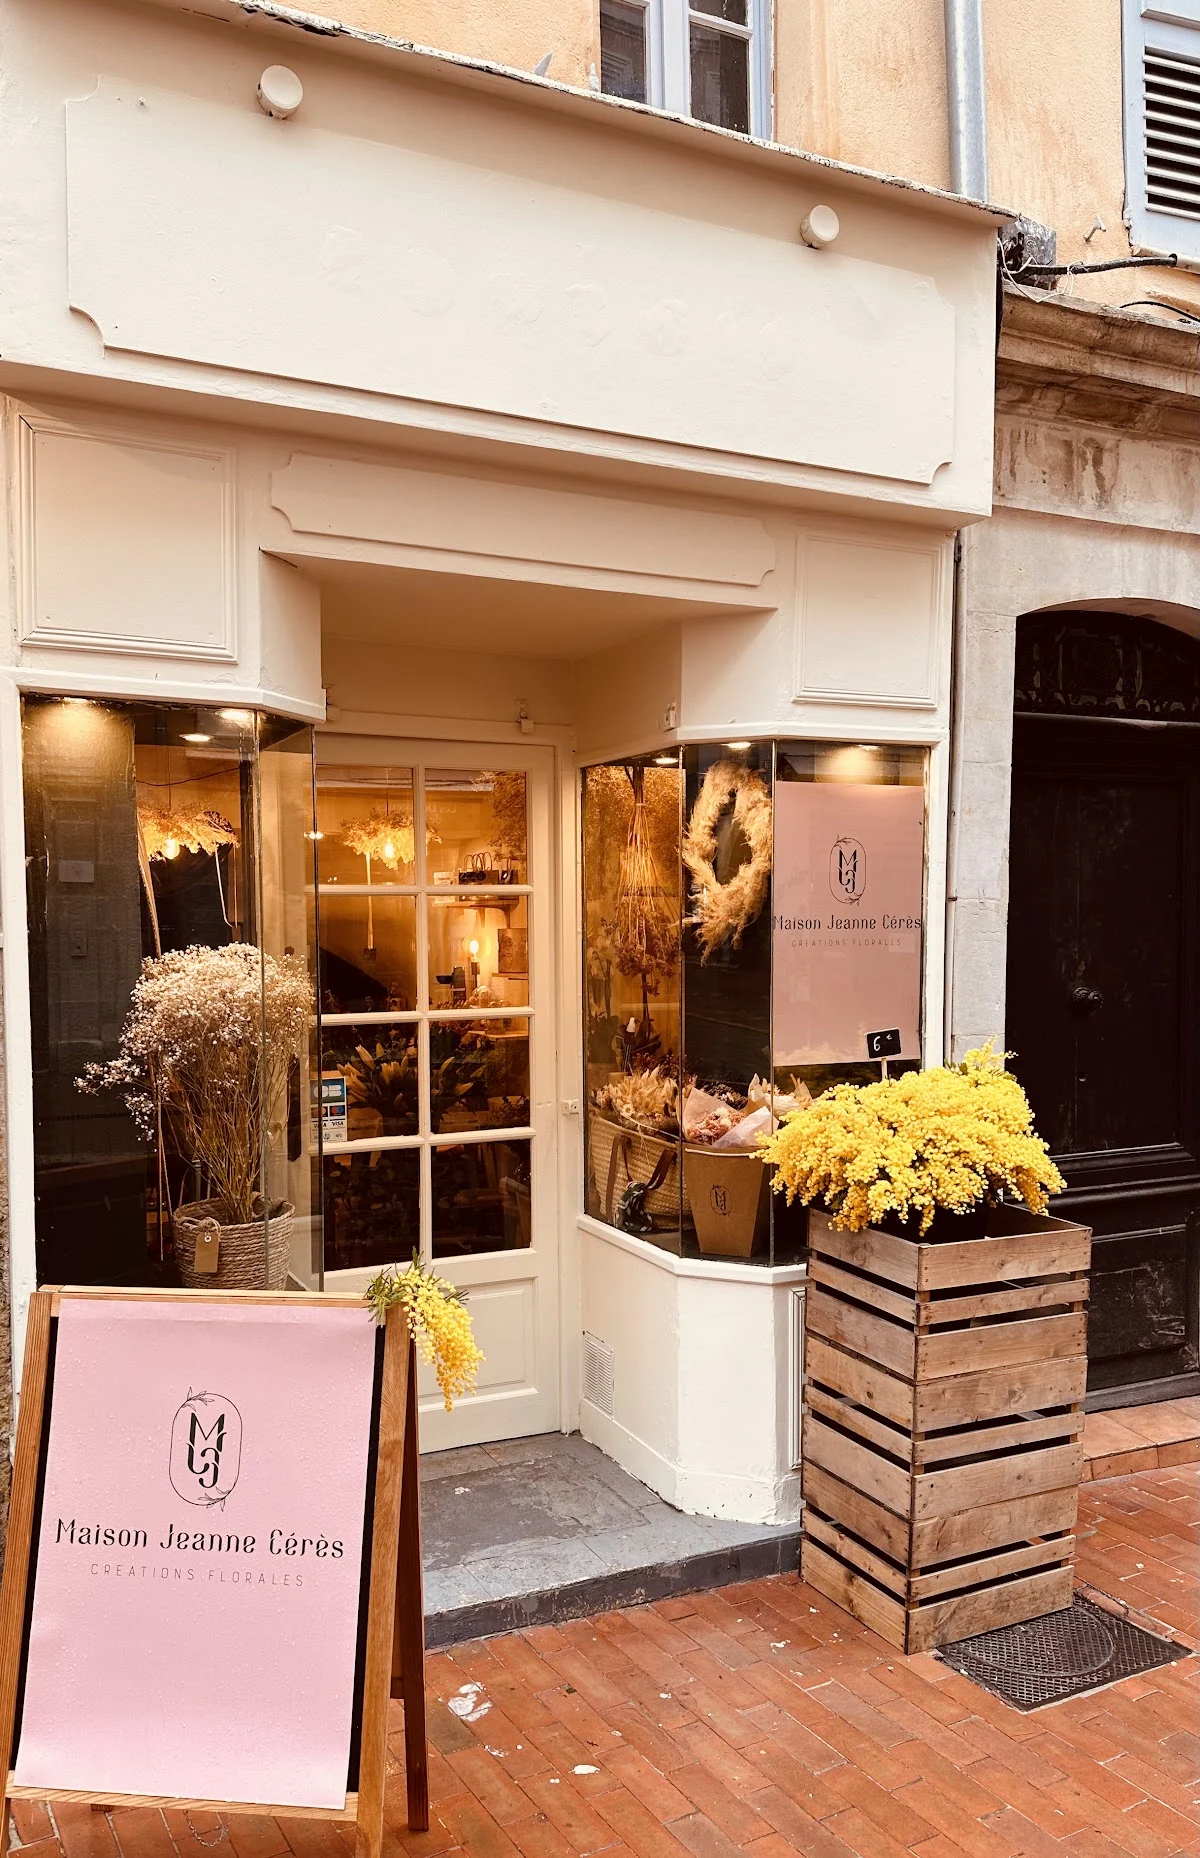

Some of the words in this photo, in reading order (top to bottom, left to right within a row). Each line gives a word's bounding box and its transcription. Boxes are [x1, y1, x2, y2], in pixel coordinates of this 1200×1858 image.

[774, 915, 821, 930] Maison
[827, 915, 876, 930] Jeanne
[882, 914, 922, 929] Cérès
[791, 939, 847, 948] CREATIONS
[852, 938, 902, 946] FLORALES
[55, 1518, 148, 1548] Maison
[160, 1523, 256, 1554] Jeanne
[269, 1528, 344, 1559] Cérès
[90, 1563, 196, 1581] CREATIONS
[208, 1570, 304, 1587] FLORALES
